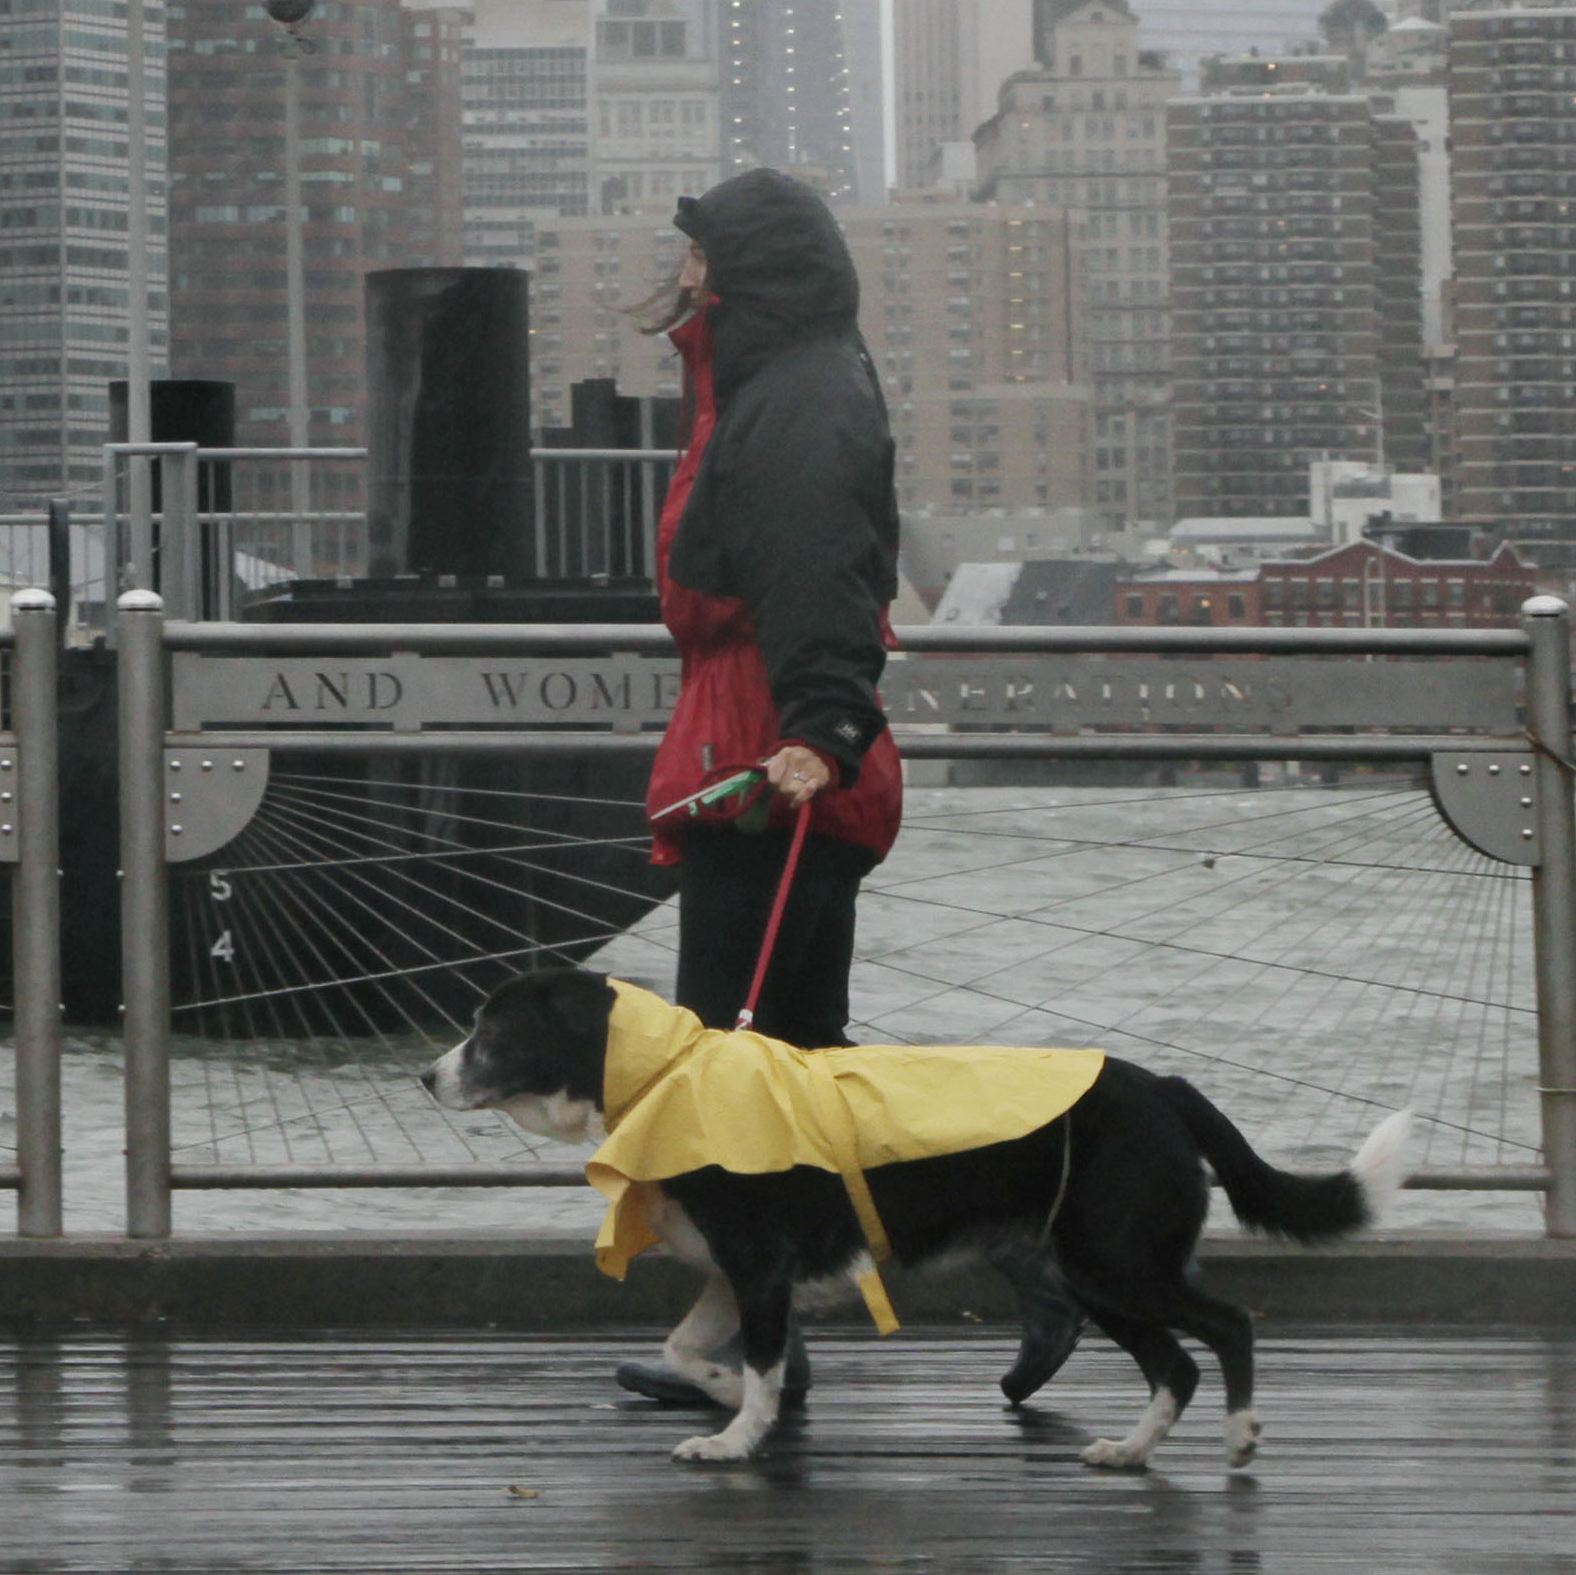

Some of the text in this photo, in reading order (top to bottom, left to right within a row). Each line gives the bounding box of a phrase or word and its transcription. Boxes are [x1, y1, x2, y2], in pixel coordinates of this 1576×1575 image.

[259, 671, 405, 711] AND
[209, 868, 233, 901] 5
[209, 929, 235, 963] 4
